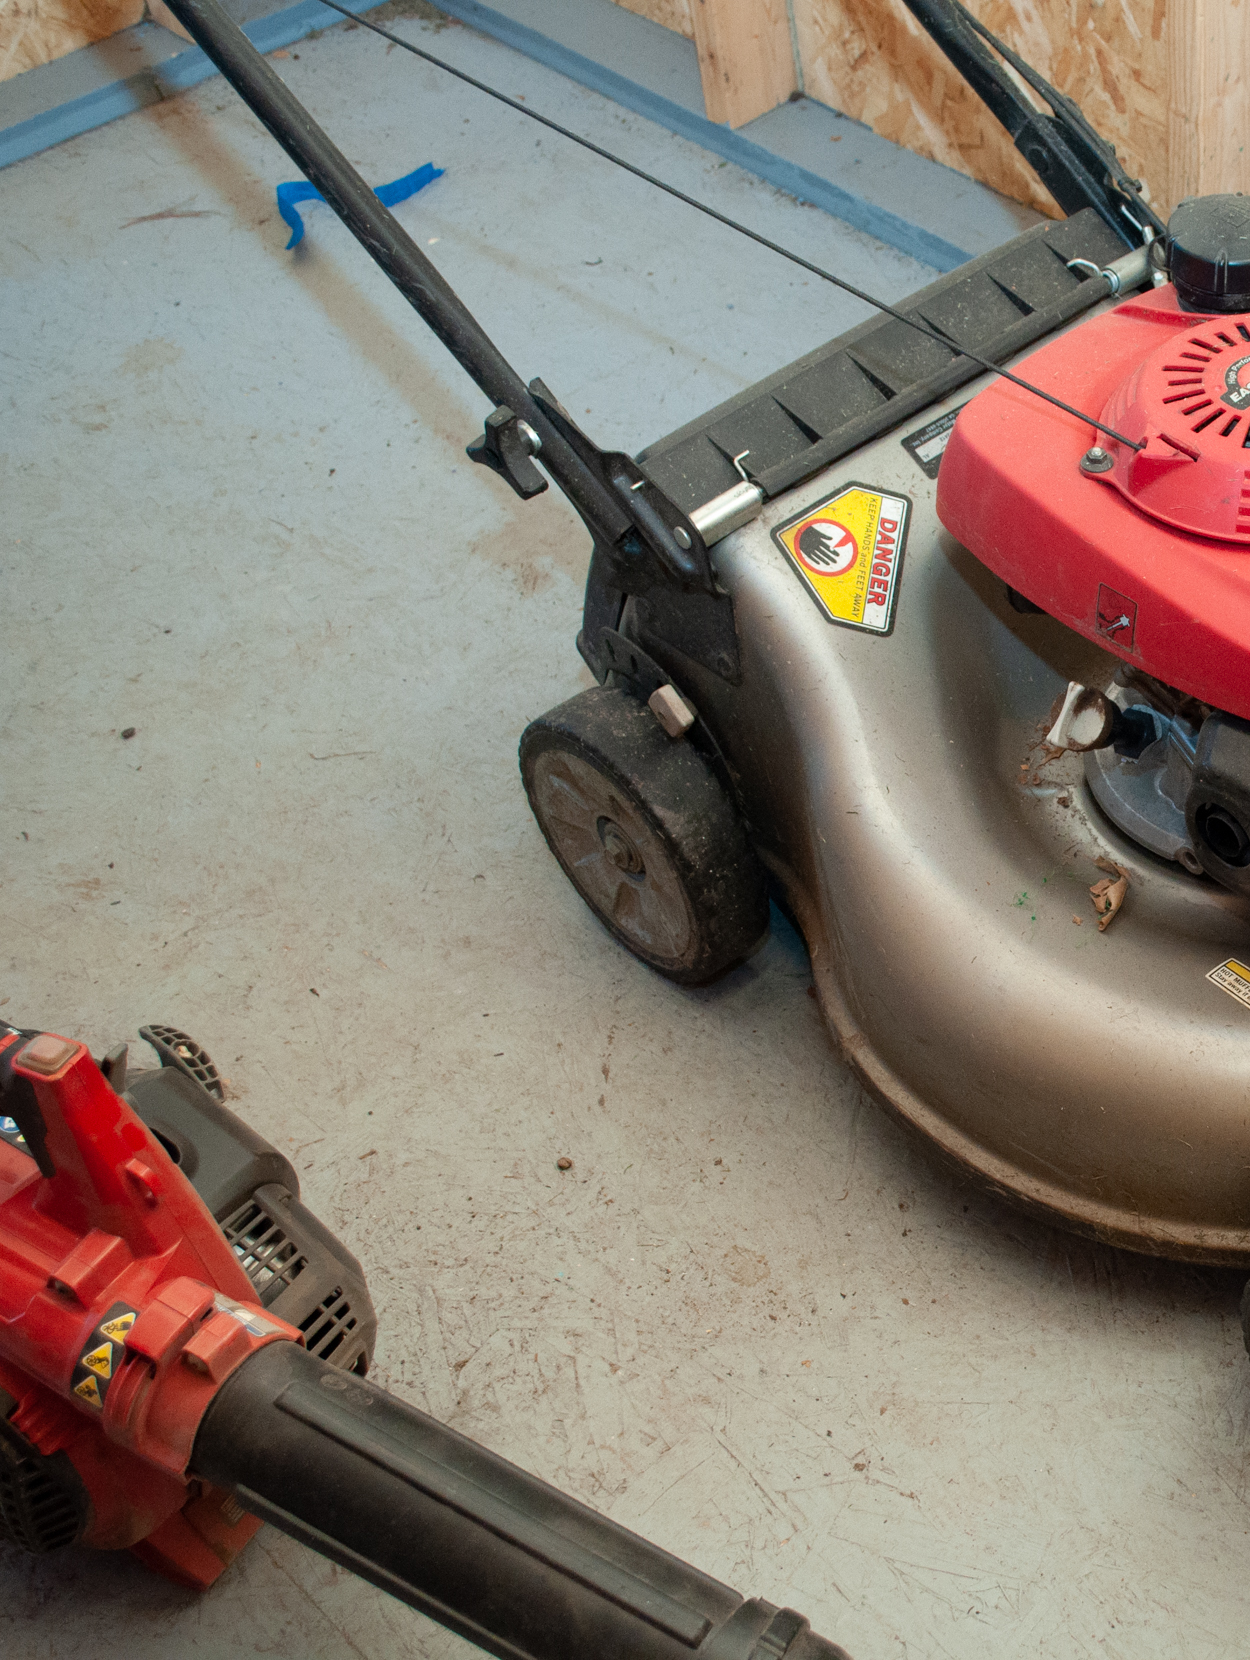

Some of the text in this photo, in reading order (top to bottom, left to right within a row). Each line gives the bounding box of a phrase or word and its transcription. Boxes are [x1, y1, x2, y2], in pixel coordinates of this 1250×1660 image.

[1228, 371, 1237, 384] High
[851, 497, 878, 618] KEEP HANDS and FEET AWAY
[867, 517, 898, 606] DANGER
[1215, 972, 1227, 983] Stay
[1227, 981, 1241, 993] away
[1220, 968, 1233, 978] HOT
